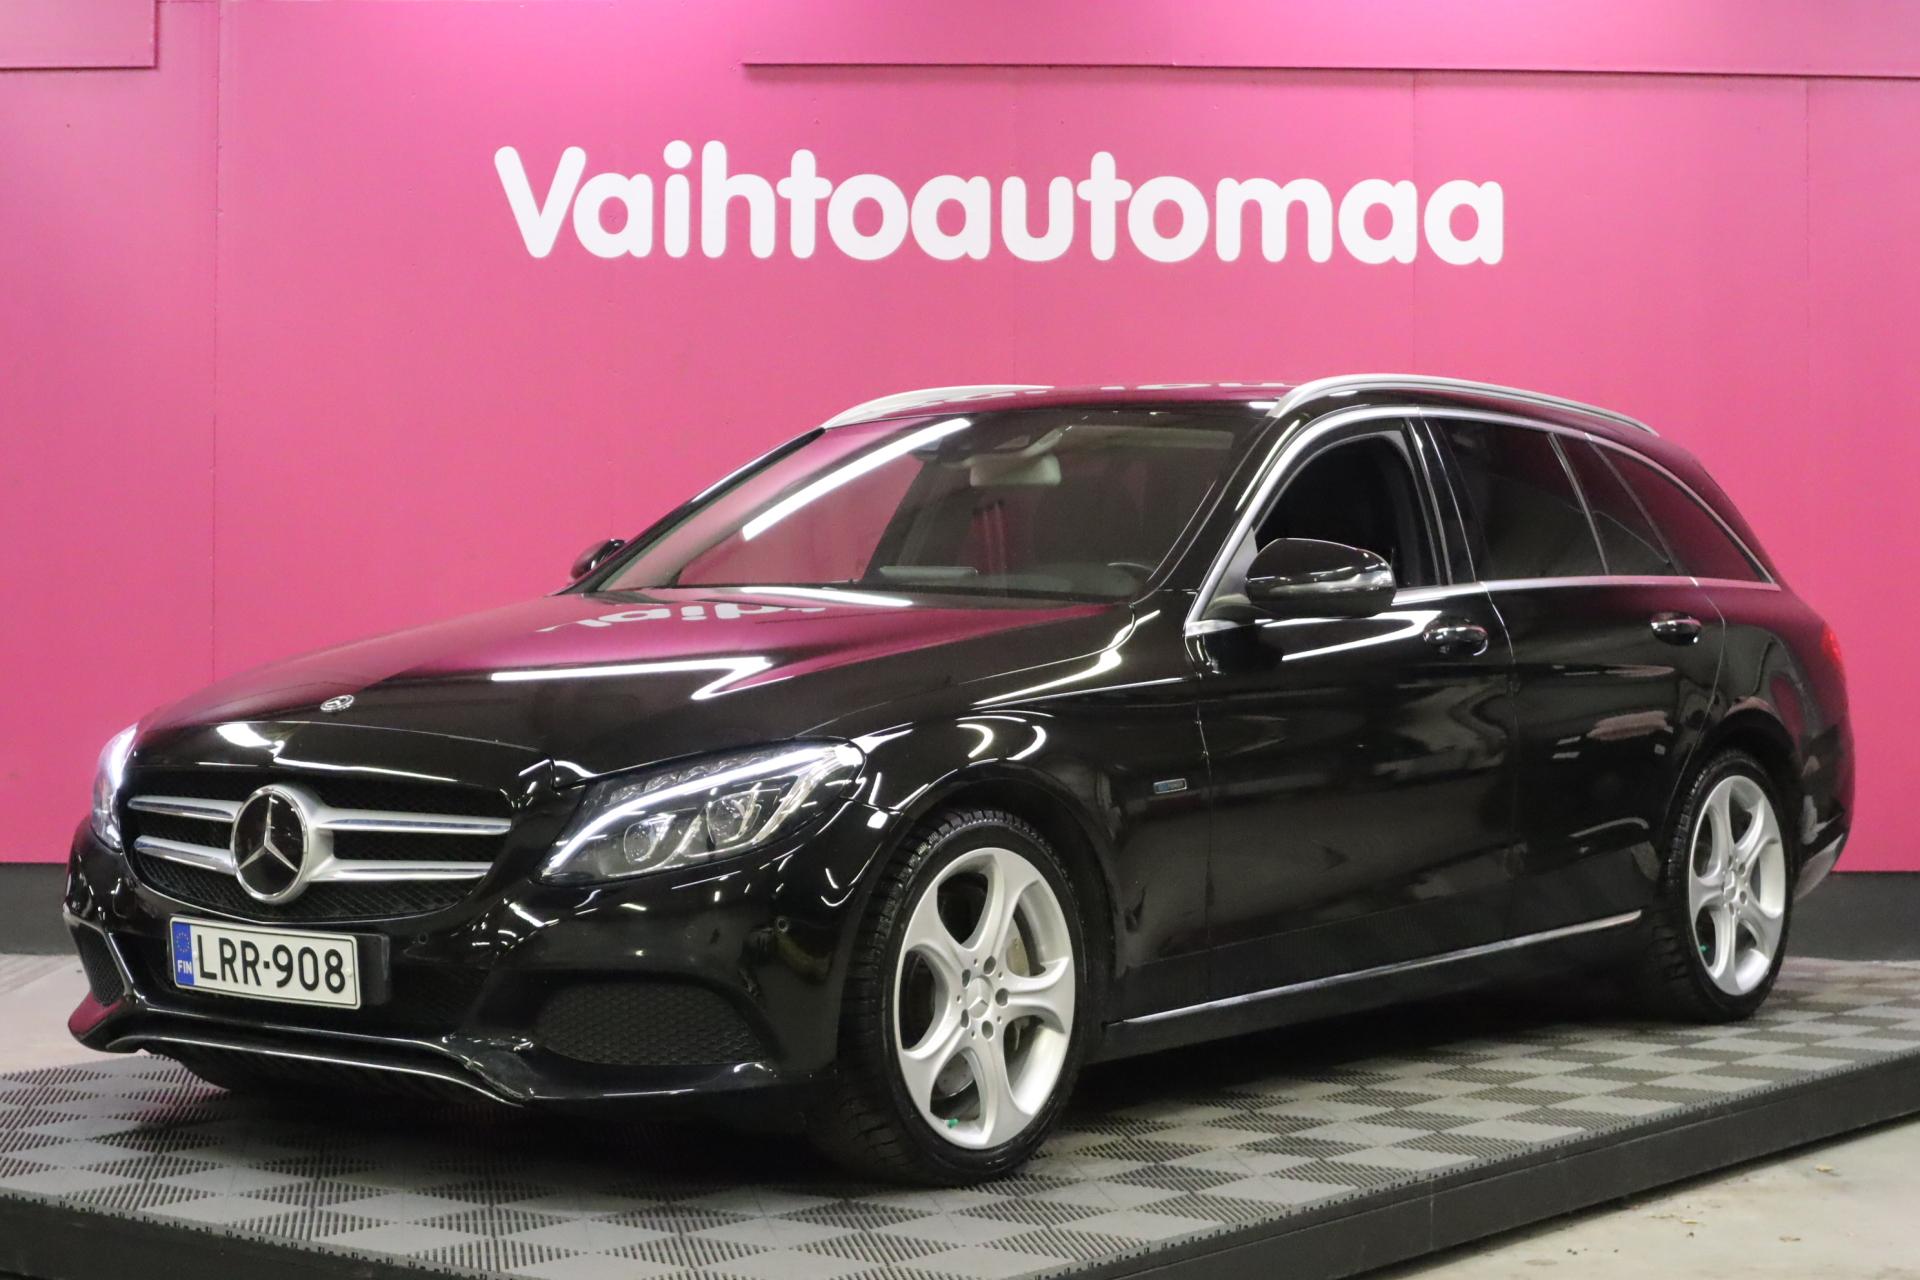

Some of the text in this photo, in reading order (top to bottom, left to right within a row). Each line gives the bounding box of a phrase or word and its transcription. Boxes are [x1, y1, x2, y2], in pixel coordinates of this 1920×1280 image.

[493, 140, 1504, 265] Vaihtoautomaa
[177, 960, 193, 975] FIN
[197, 934, 346, 994] LRR-908
